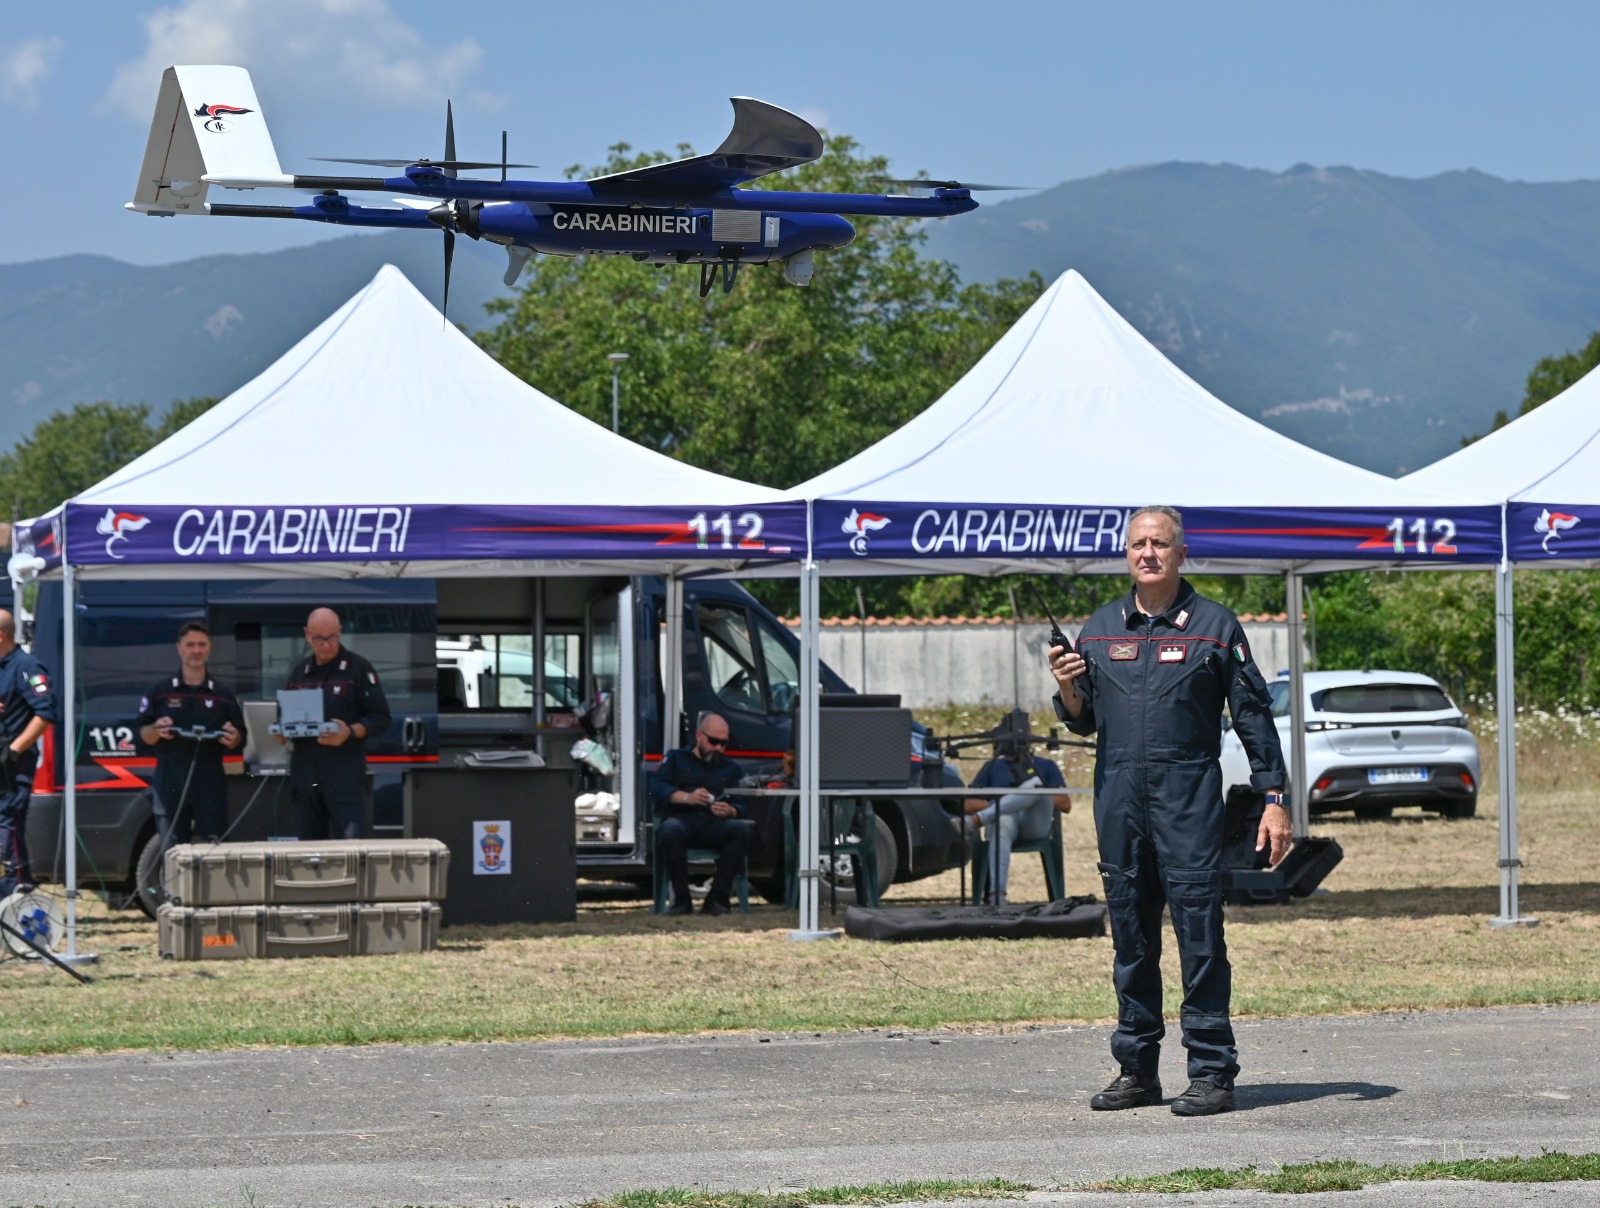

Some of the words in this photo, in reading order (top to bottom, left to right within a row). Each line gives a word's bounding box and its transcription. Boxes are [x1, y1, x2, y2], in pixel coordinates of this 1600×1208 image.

[553, 212, 697, 234] CARABINIERI
[173, 507, 411, 555] CARABINIERI
[687, 512, 765, 549] 112
[911, 509, 1130, 552] CARABINIERI
[1386, 517, 1458, 553] 112
[89, 726, 136, 750] 112
